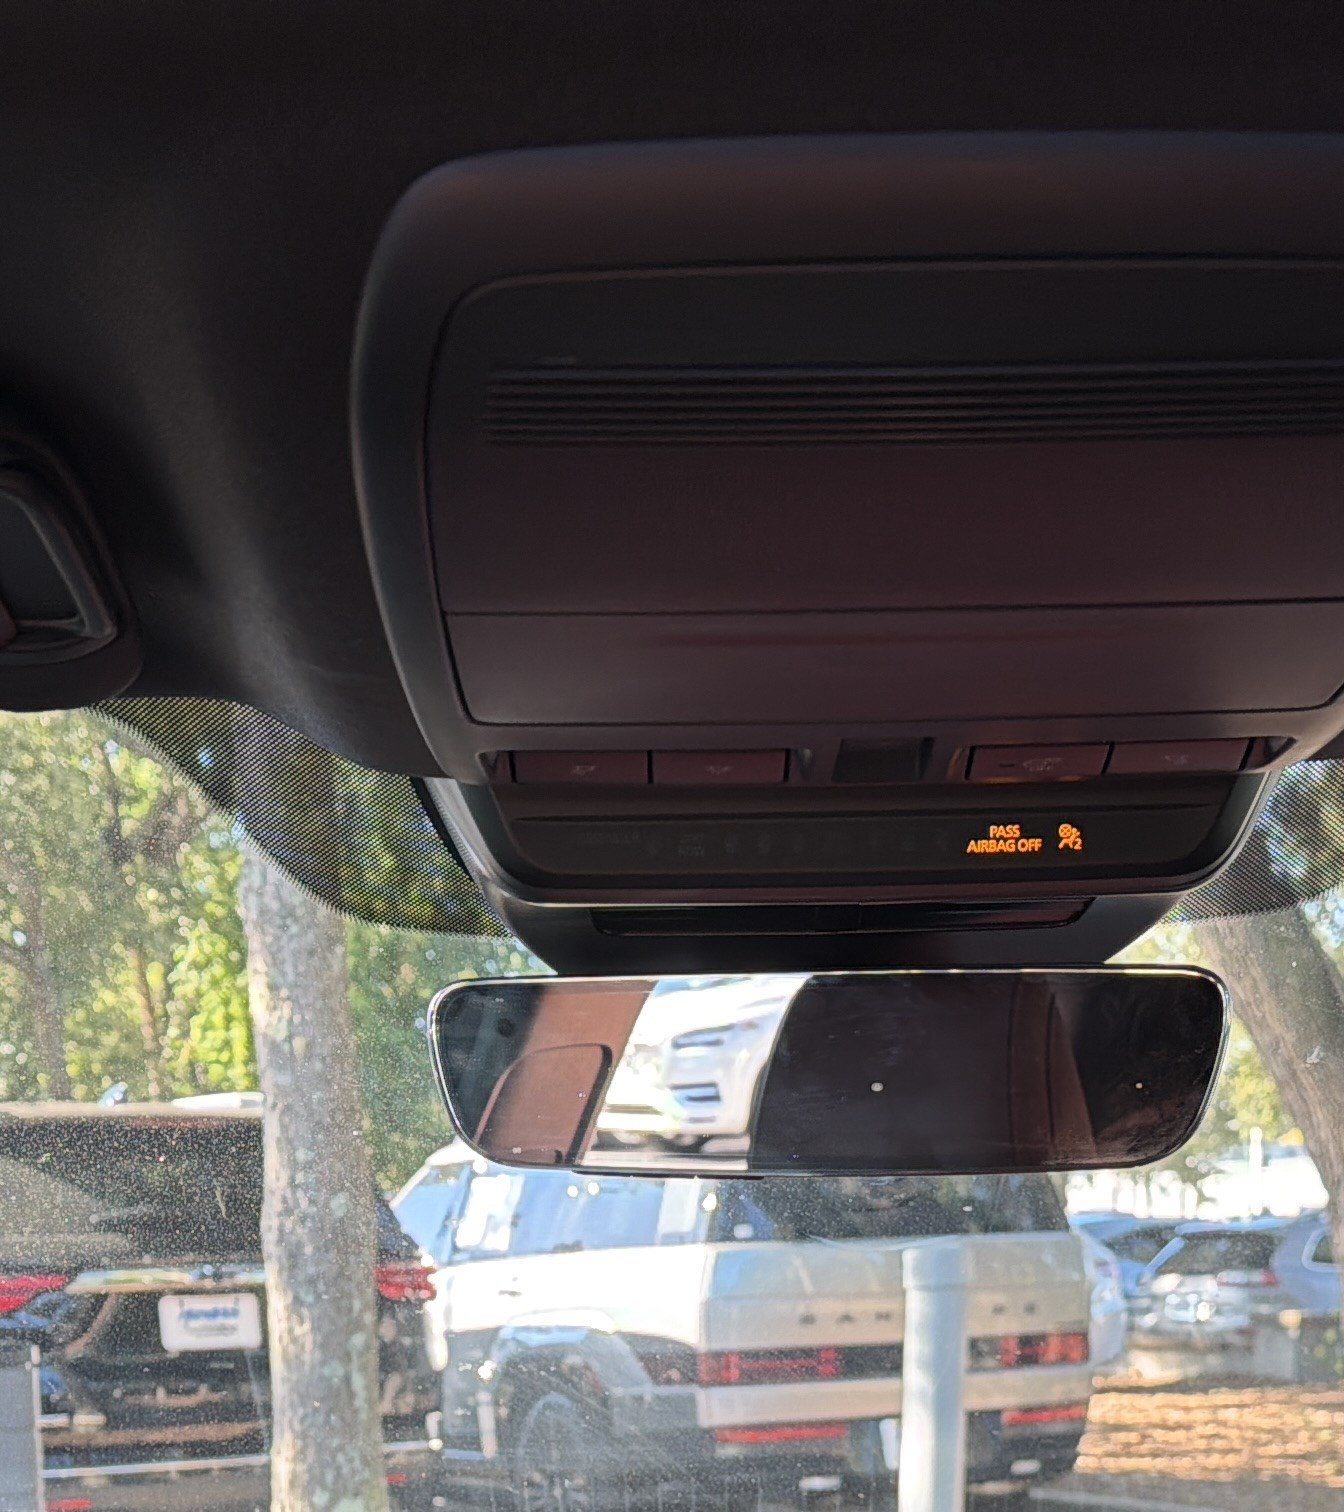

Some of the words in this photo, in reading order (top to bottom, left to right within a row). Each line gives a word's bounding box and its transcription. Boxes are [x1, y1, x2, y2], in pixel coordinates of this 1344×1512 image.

[989, 824, 1021, 839] PASS
[966, 838, 1016, 853] AIRBAG
[1017, 838, 1043, 852] OFF
